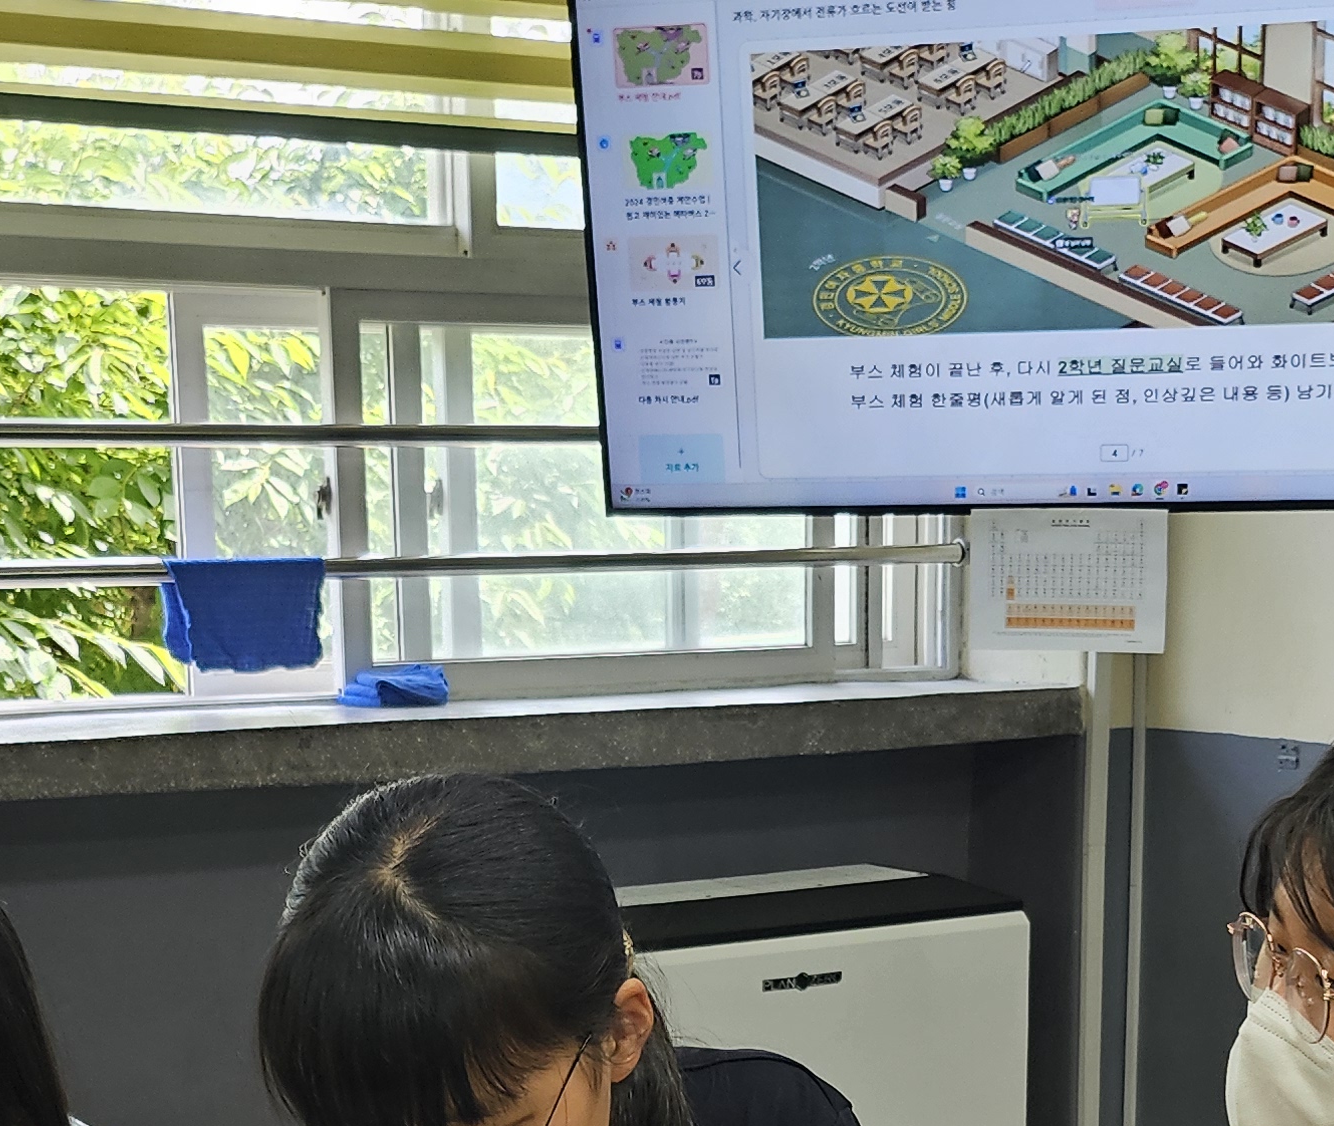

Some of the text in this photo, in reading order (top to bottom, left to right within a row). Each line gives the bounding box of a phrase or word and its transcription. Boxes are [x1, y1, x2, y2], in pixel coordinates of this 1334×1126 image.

[850, 4, 881, 15] 흐르는
[886, 1, 917, 13] 도선이
[850, 364, 883, 379] 부스
[890, 363, 940, 379] 체험이
[948, 362, 981, 377] 끝난
[989, 361, 1011, 378] 후,
[1018, 360, 1051, 376] 다시
[1058, 358, 1102, 376] 2학년
[1111, 355, 1202, 374] 질문교실로
[1209, 355, 1263, 371] 들어와
[851, 394, 884, 409] 부스
[891, 393, 923, 409] 체험
[931, 390, 1041, 409] 한줄평(새롭게
[1050, 389, 1083, 406] 알게
[1091, 389, 1106, 405] 된
[1115, 387, 1137, 405] 점,
[1144, 386, 1215, 404] 인상깊은
[1223, 385, 1258, 402] 내용
[1266, 384, 1290, 403] 등)
[1112, 449, 1118, 457] 4
[764, 978, 796, 991] PLAN
